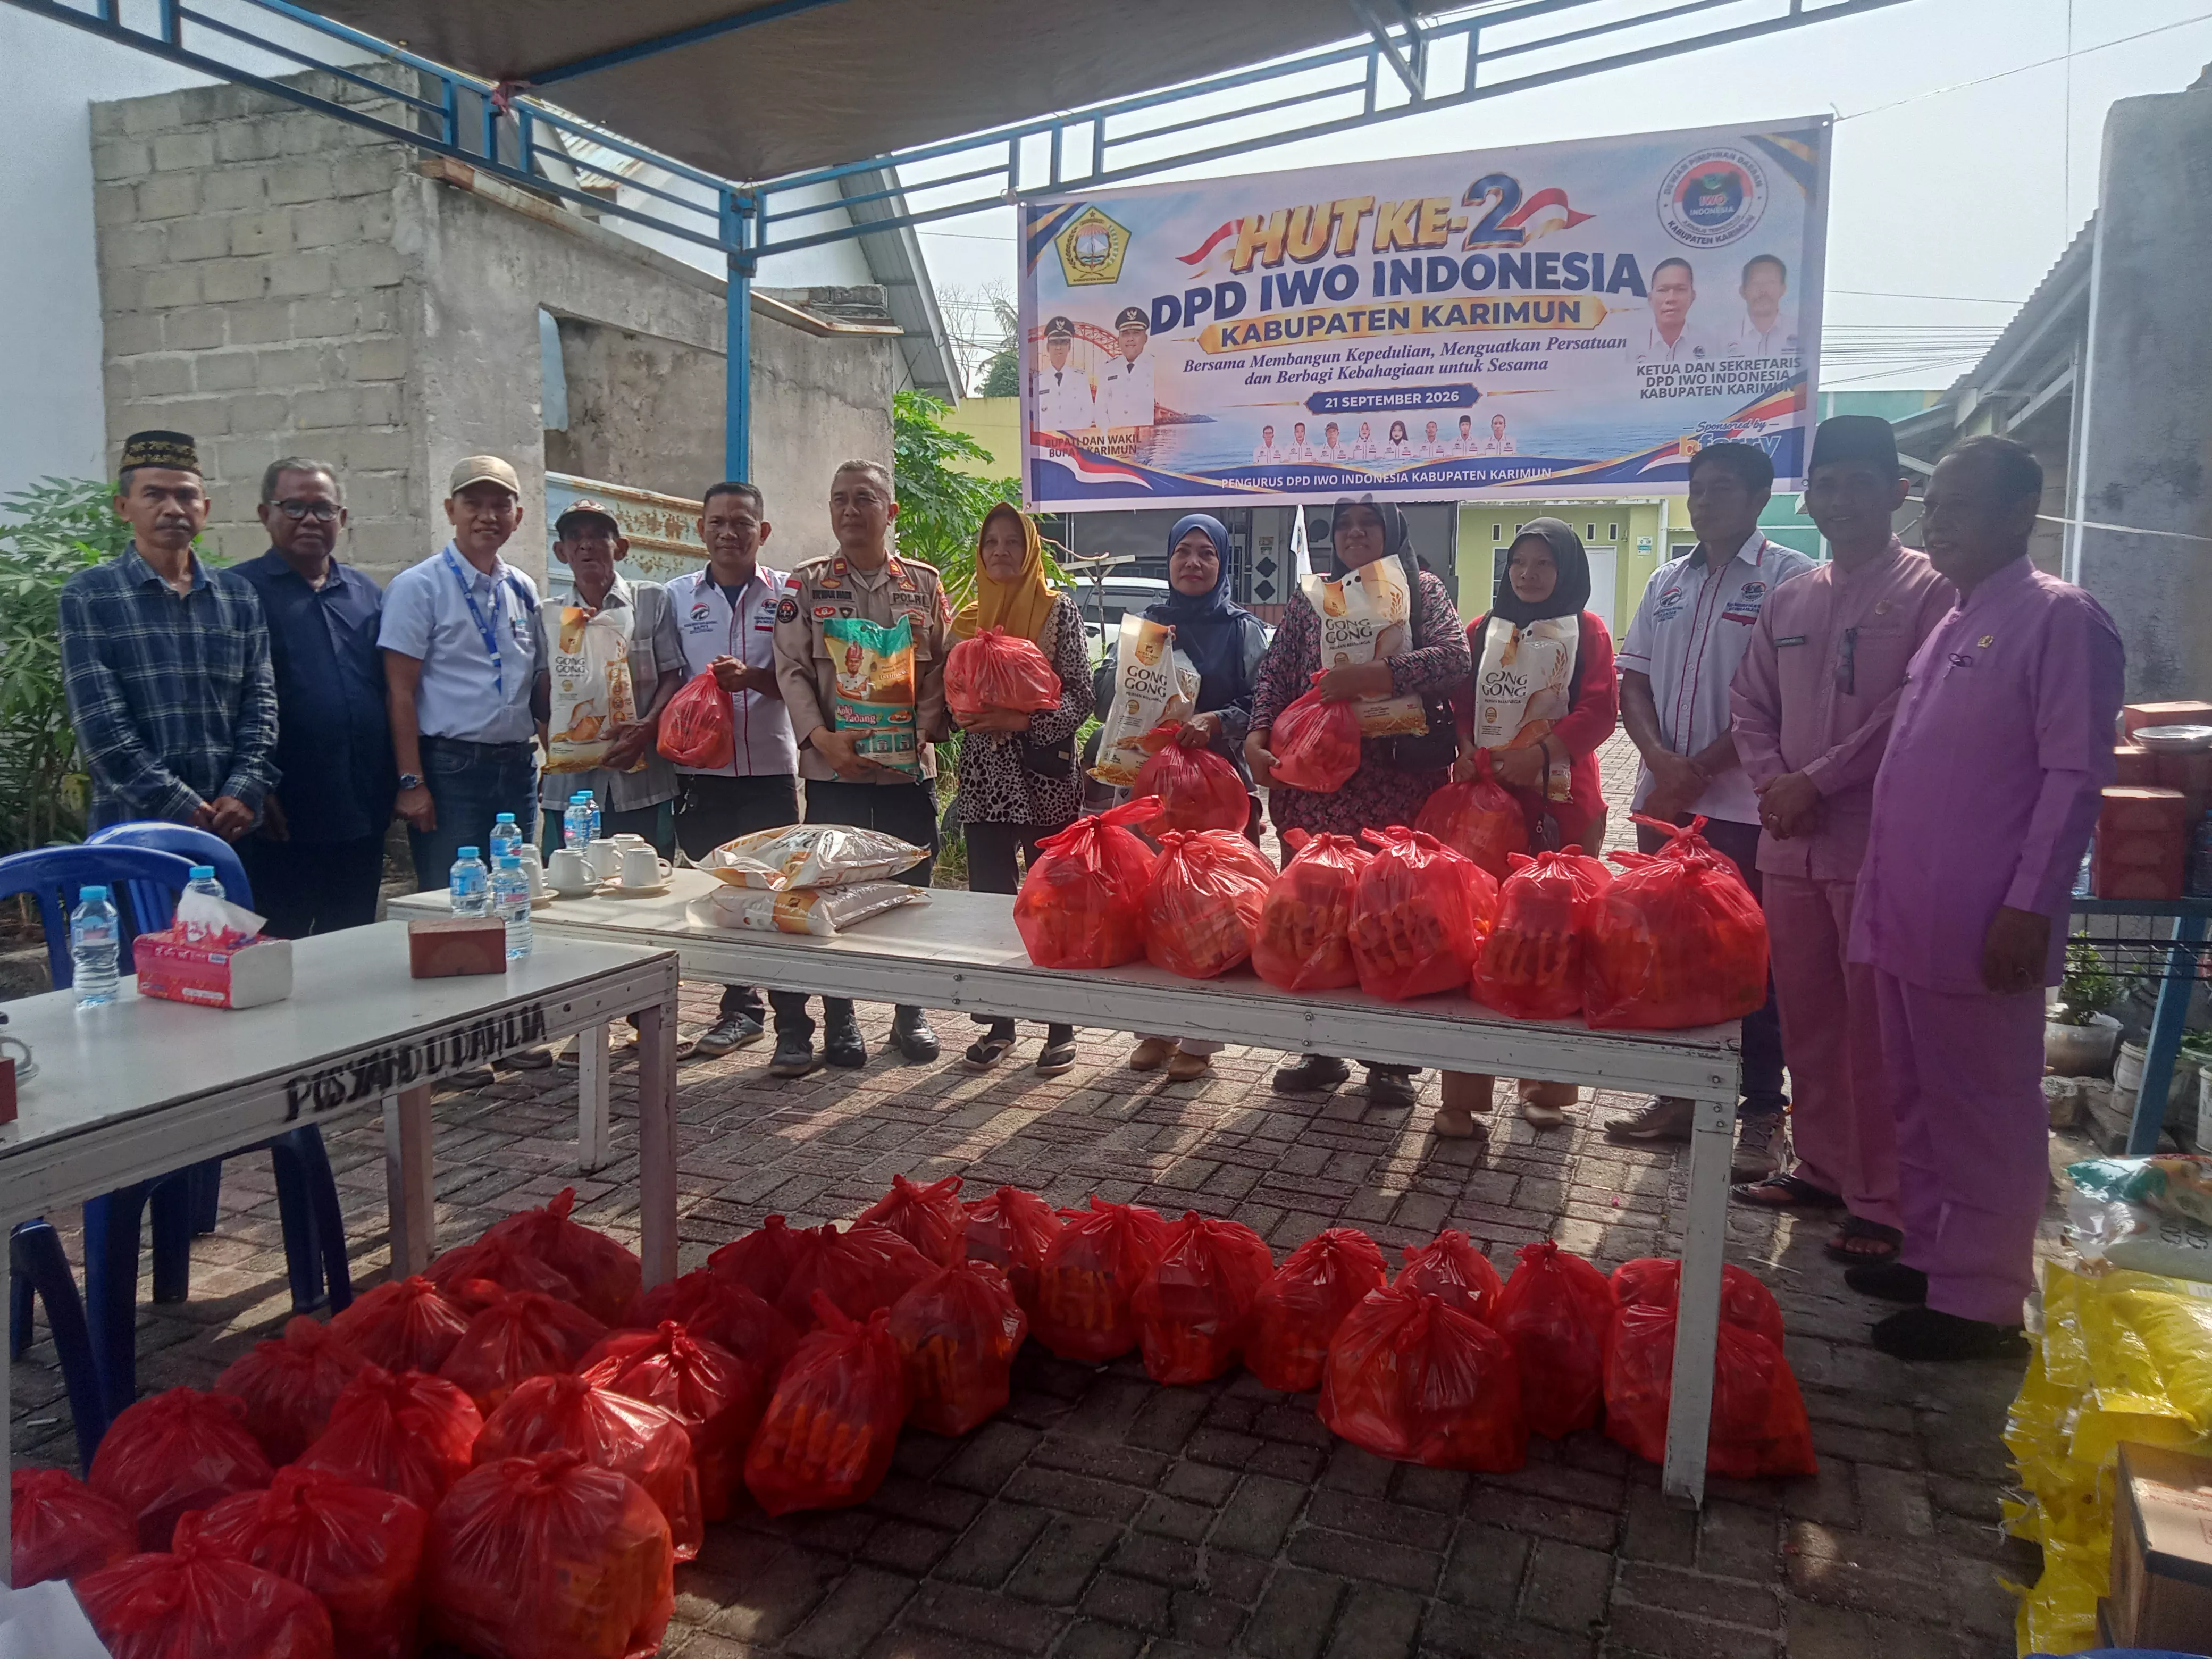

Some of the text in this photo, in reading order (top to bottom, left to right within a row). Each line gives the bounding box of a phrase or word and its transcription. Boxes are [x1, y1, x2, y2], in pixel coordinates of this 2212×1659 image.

[1230, 171, 1526, 275] HUT KE-2
[1668, 220, 1713, 244] KABUPATEN
[1715, 215, 1754, 242] KARIMUN
[1149, 252, 1648, 337] DPD IWO INDONESIA
[1221, 301, 1581, 348] KABUPATEN KARIMUN
[1183, 336, 1627, 373] Bersama Membangun Kepedulian, Menguatkan Persatuan
[1245, 358, 1549, 386] dan Berbagi Kebahagiaan untuk Sesama
[1637, 357, 1802, 376] KETUA DAN SEKRETARIS
[1646, 370, 1789, 388] DPD IWO INDONESIA
[1325, 391, 1460, 408] 21 SEPTEMBER 2026
[1640, 382, 1795, 399] KABUPATEN KARIMUN
[1695, 419, 1766, 433] Sponsored by
[1045, 434, 1142, 448] BUPATI DAN WAKIL
[1087, 445, 1137, 456] KARIMUN
[1221, 468, 1552, 488] PENGURUS DPD IWO INDONESIA KABUPATEN KARIMUN
[893, 592, 927, 604] POLRI
[1325, 618, 1370, 631] GONG
[1325, 626, 1372, 643] GONG
[1127, 665, 1167, 686] GONG
[1124, 677, 1167, 698] GONG
[845, 714, 877, 725] Padang
